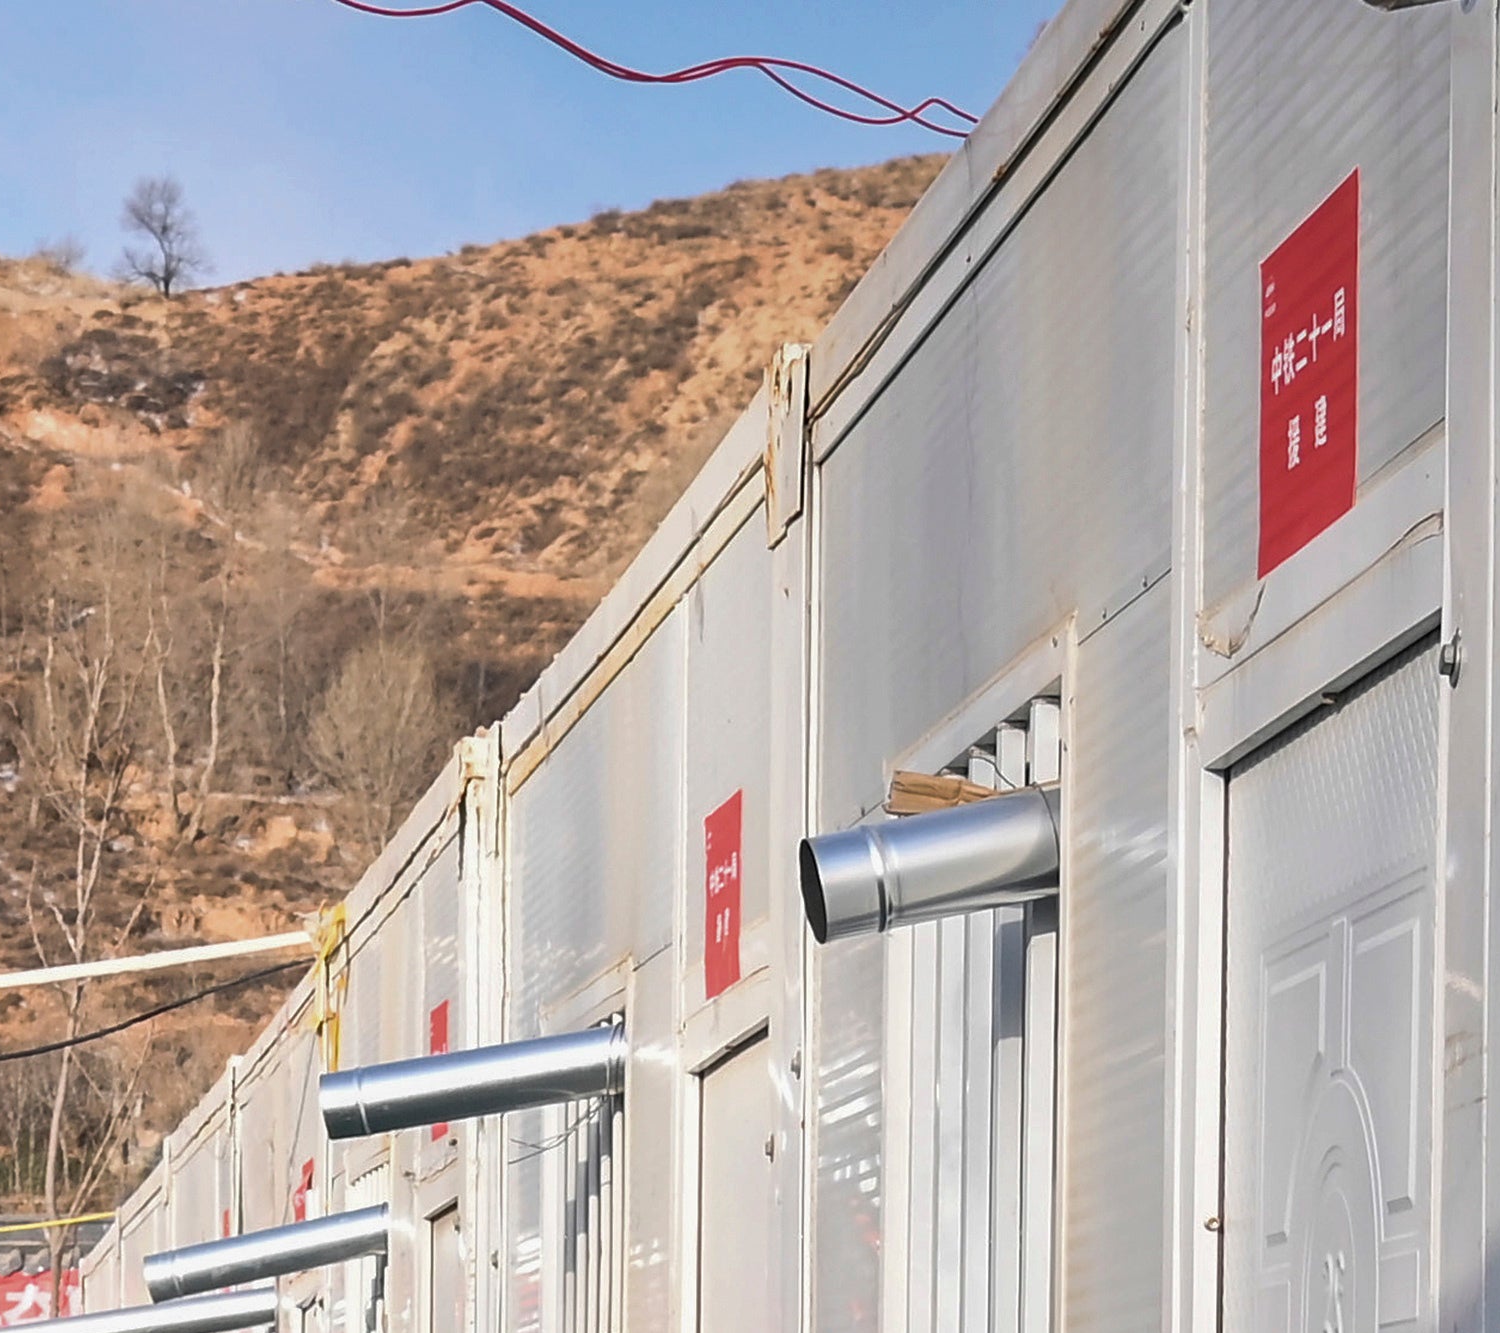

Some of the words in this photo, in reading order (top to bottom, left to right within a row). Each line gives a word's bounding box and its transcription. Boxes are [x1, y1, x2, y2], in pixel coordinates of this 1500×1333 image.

[1270, 287, 1346, 395] 中铁二十一局
